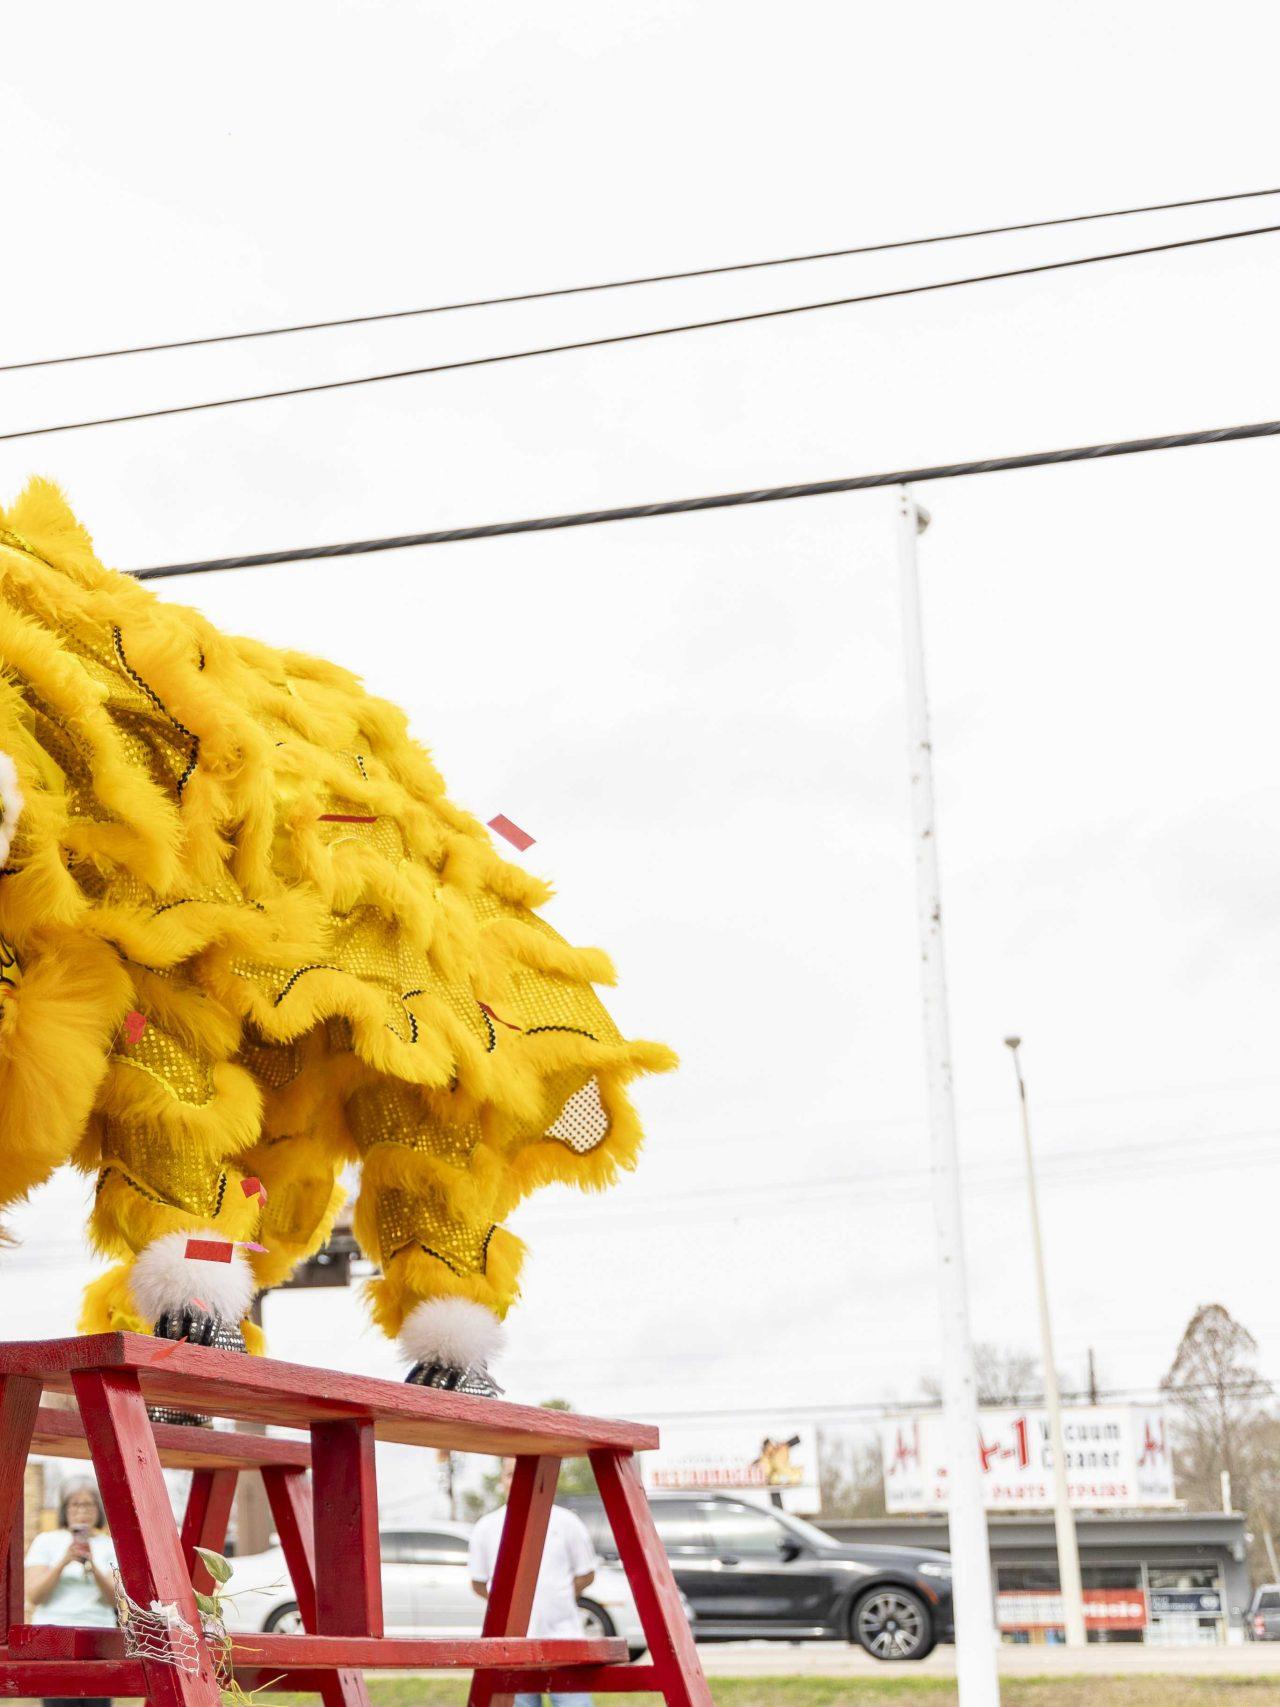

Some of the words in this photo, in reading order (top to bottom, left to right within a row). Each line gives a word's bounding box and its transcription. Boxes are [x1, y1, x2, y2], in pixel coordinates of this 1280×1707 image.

[1039, 1420, 1121, 1440] Vcuum
[1040, 1448, 1121, 1469] Ceaner
[1066, 1482, 1129, 1498] EPAIRS
